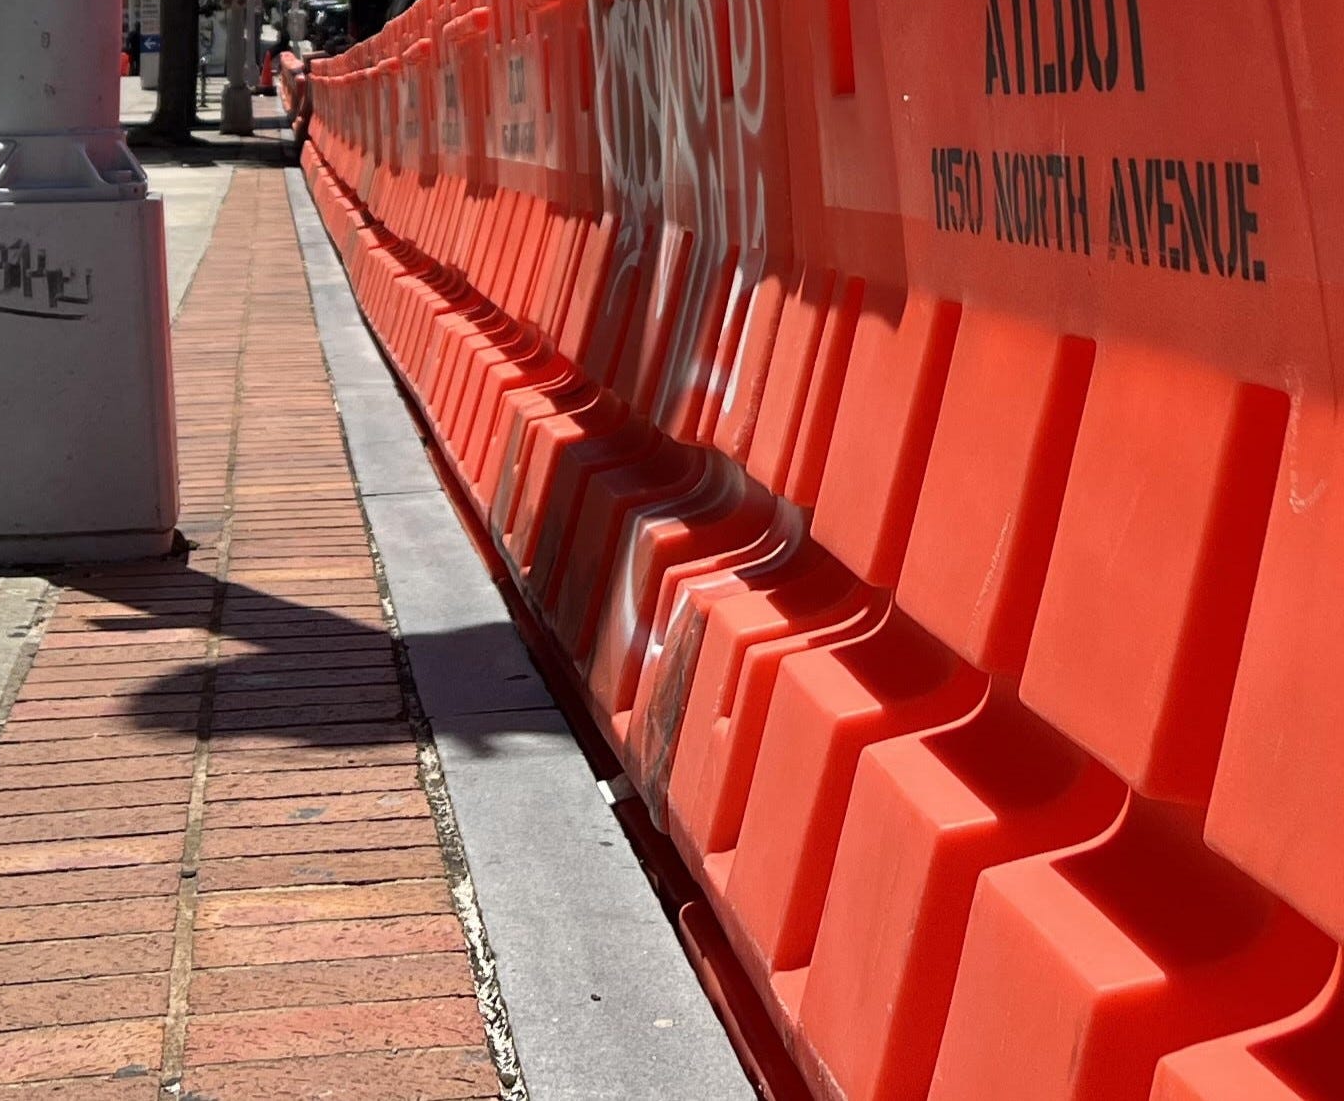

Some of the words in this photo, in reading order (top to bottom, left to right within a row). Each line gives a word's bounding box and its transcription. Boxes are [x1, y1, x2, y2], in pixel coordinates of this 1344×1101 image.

[931, 147, 984, 236] 1150
[992, 150, 1092, 256] NORTH
[1107, 157, 1267, 283] AVENUE
